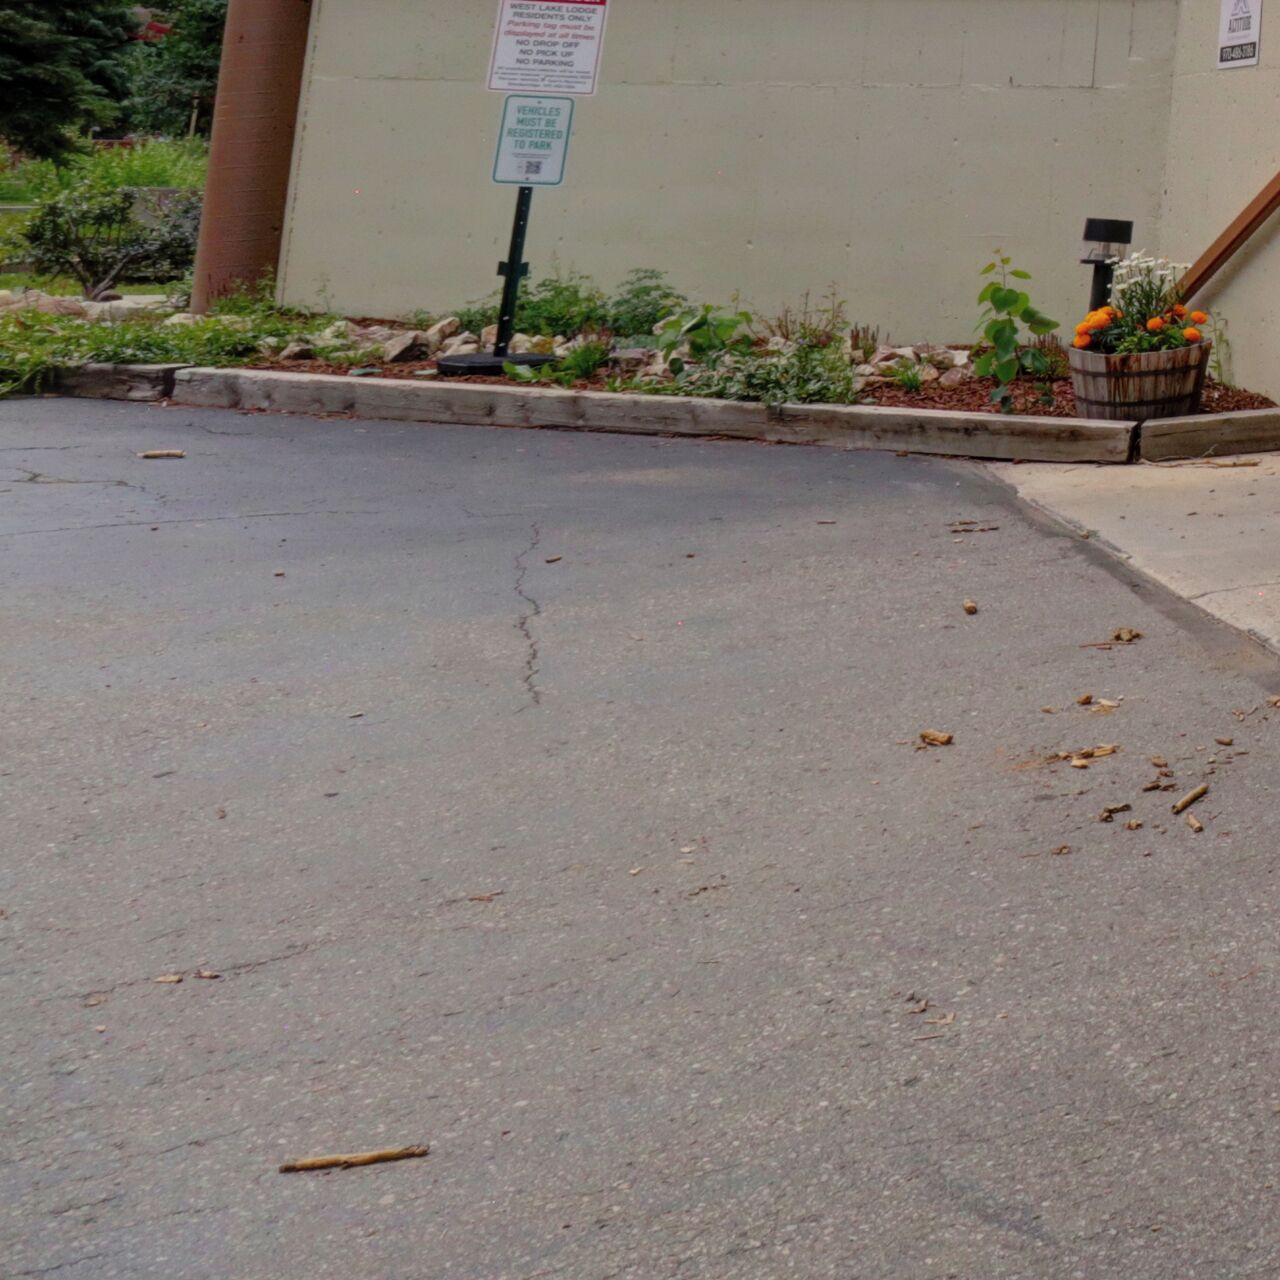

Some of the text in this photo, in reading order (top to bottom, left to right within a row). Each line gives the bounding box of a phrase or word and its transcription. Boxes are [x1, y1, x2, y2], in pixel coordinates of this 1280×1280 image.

[539, 4, 563, 12] LAKE
[566, 6, 598, 14] LODGE
[512, 11, 592, 22] RESIDENTS ONLY
[507, 20, 541, 28] Parking
[559, 23, 582, 31] must
[504, 30, 546, 39] displayed
[532, 40, 560, 48] DROP
[562, 41, 581, 49] OFF
[535, 49, 558, 57] PICK
[532, 59, 574, 67] PARKING
[517, 105, 561, 117] VEHICLES
[516, 117, 558, 128] MUST BE
[507, 128, 563, 139] REGISTERED
[514, 140, 552, 150] TO PARK
